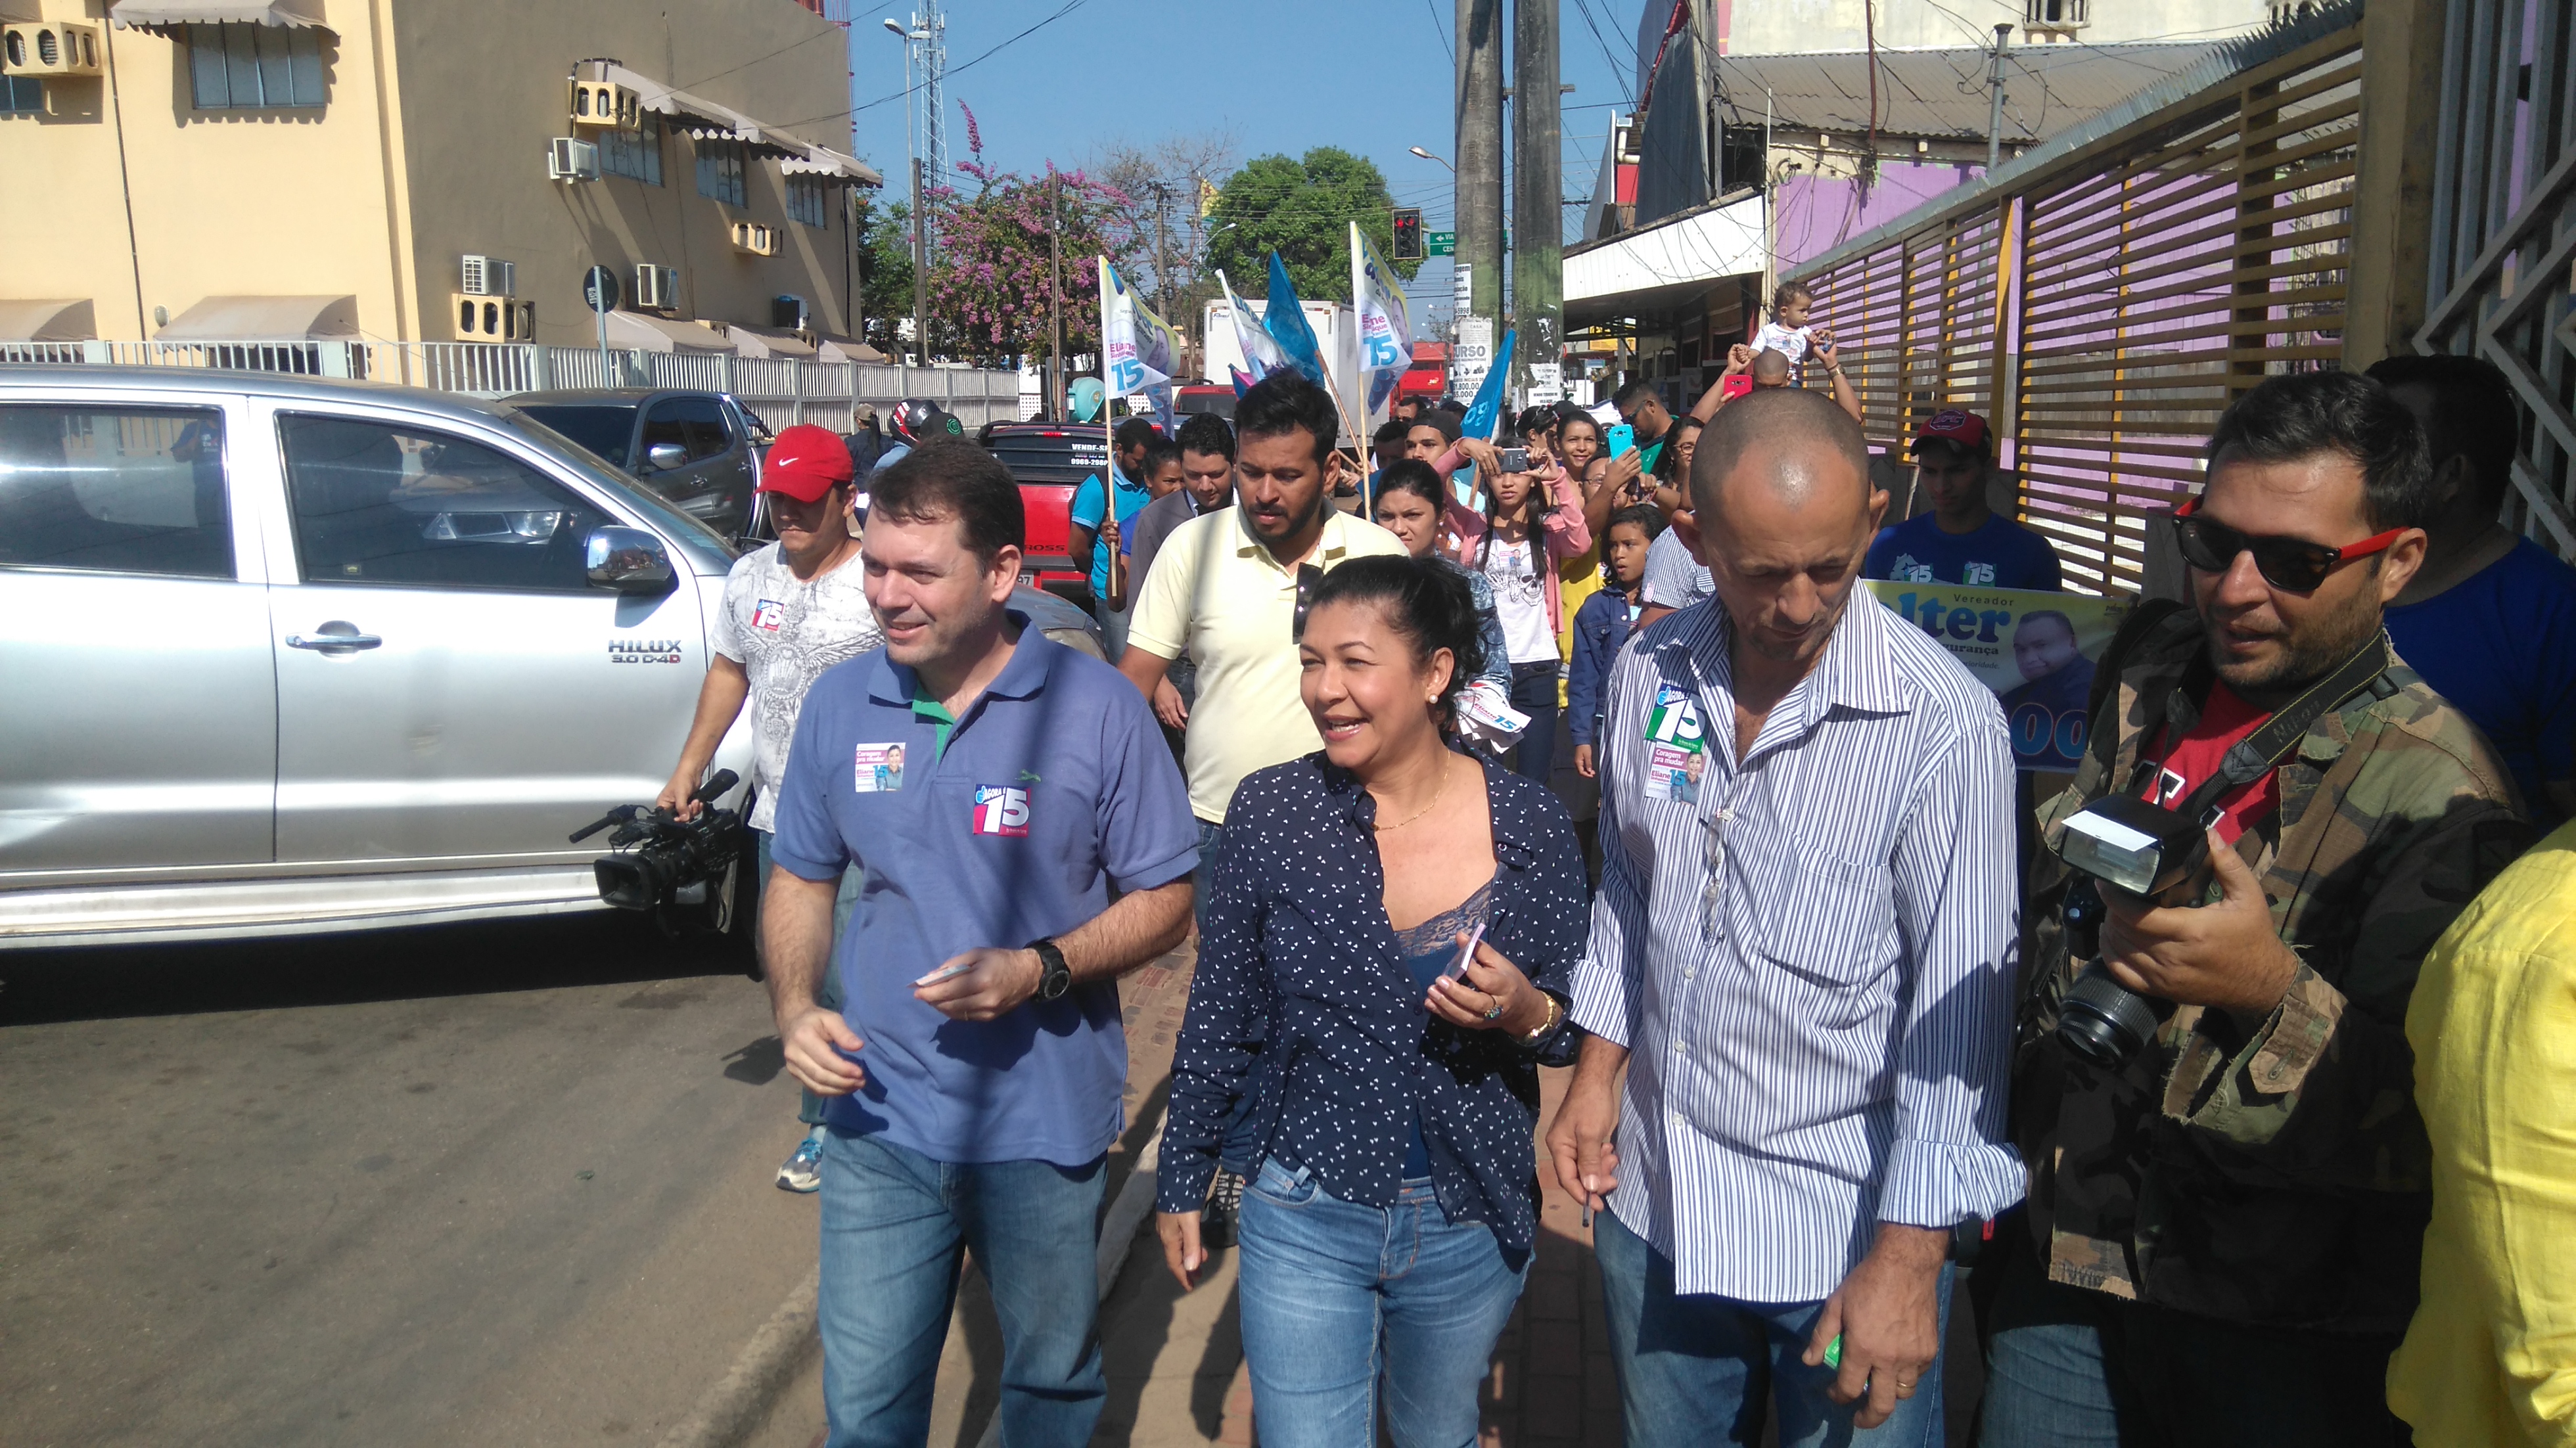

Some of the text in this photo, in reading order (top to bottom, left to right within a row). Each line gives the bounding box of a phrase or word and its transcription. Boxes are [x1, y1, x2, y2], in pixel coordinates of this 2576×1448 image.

[1364, 334, 1398, 367] 15
[1454, 345, 1486, 357] URSO
[1111, 359, 1145, 392] 15
[1909, 565, 1933, 583] 15
[1968, 563, 1994, 585] 15
[1954, 593, 2015, 606] Vereador
[756, 602, 783, 627] 15
[1884, 592, 2012, 643] lter
[609, 640, 681, 653] HILUX
[612, 654, 639, 664] 3.0
[1665, 690, 1685, 703] AGORA
[1494, 715, 1517, 730] 15
[1655, 693, 1707, 742] 15
[1655, 748, 1682, 759] Coragem
[1665, 757, 1684, 767] mudar
[873, 765, 888, 778] 15
[1651, 770, 1671, 779] Eliane
[1669, 769, 1687, 785] 15
[983, 787, 1002, 800] AGORA
[983, 787, 1030, 834] 15
